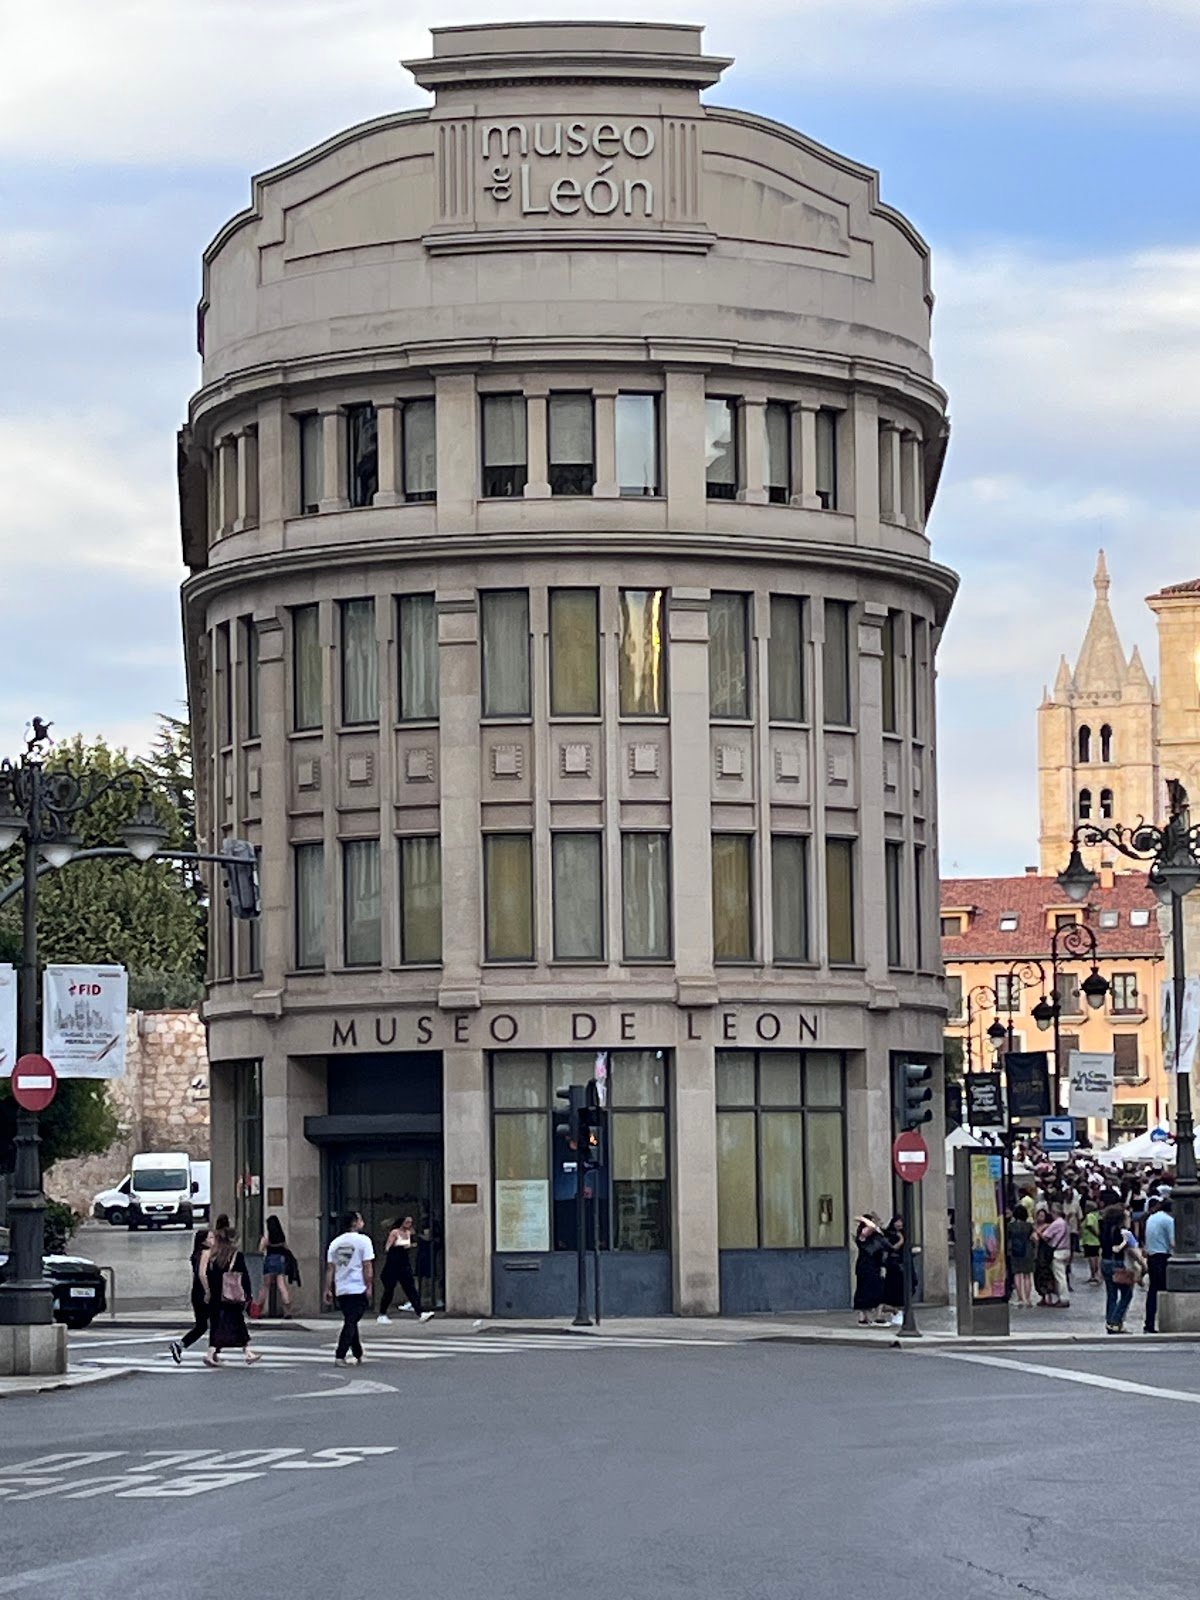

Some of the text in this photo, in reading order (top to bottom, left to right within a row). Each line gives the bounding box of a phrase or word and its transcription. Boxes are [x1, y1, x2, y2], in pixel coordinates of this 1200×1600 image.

[481, 120, 655, 159] museo
[484, 166, 512, 201] de
[520, 160, 654, 217] León
[79, 984, 102, 996] FID
[331, 1011, 819, 1048] MUSEO DE LEON
[0, 1447, 399, 1473] SOLO
